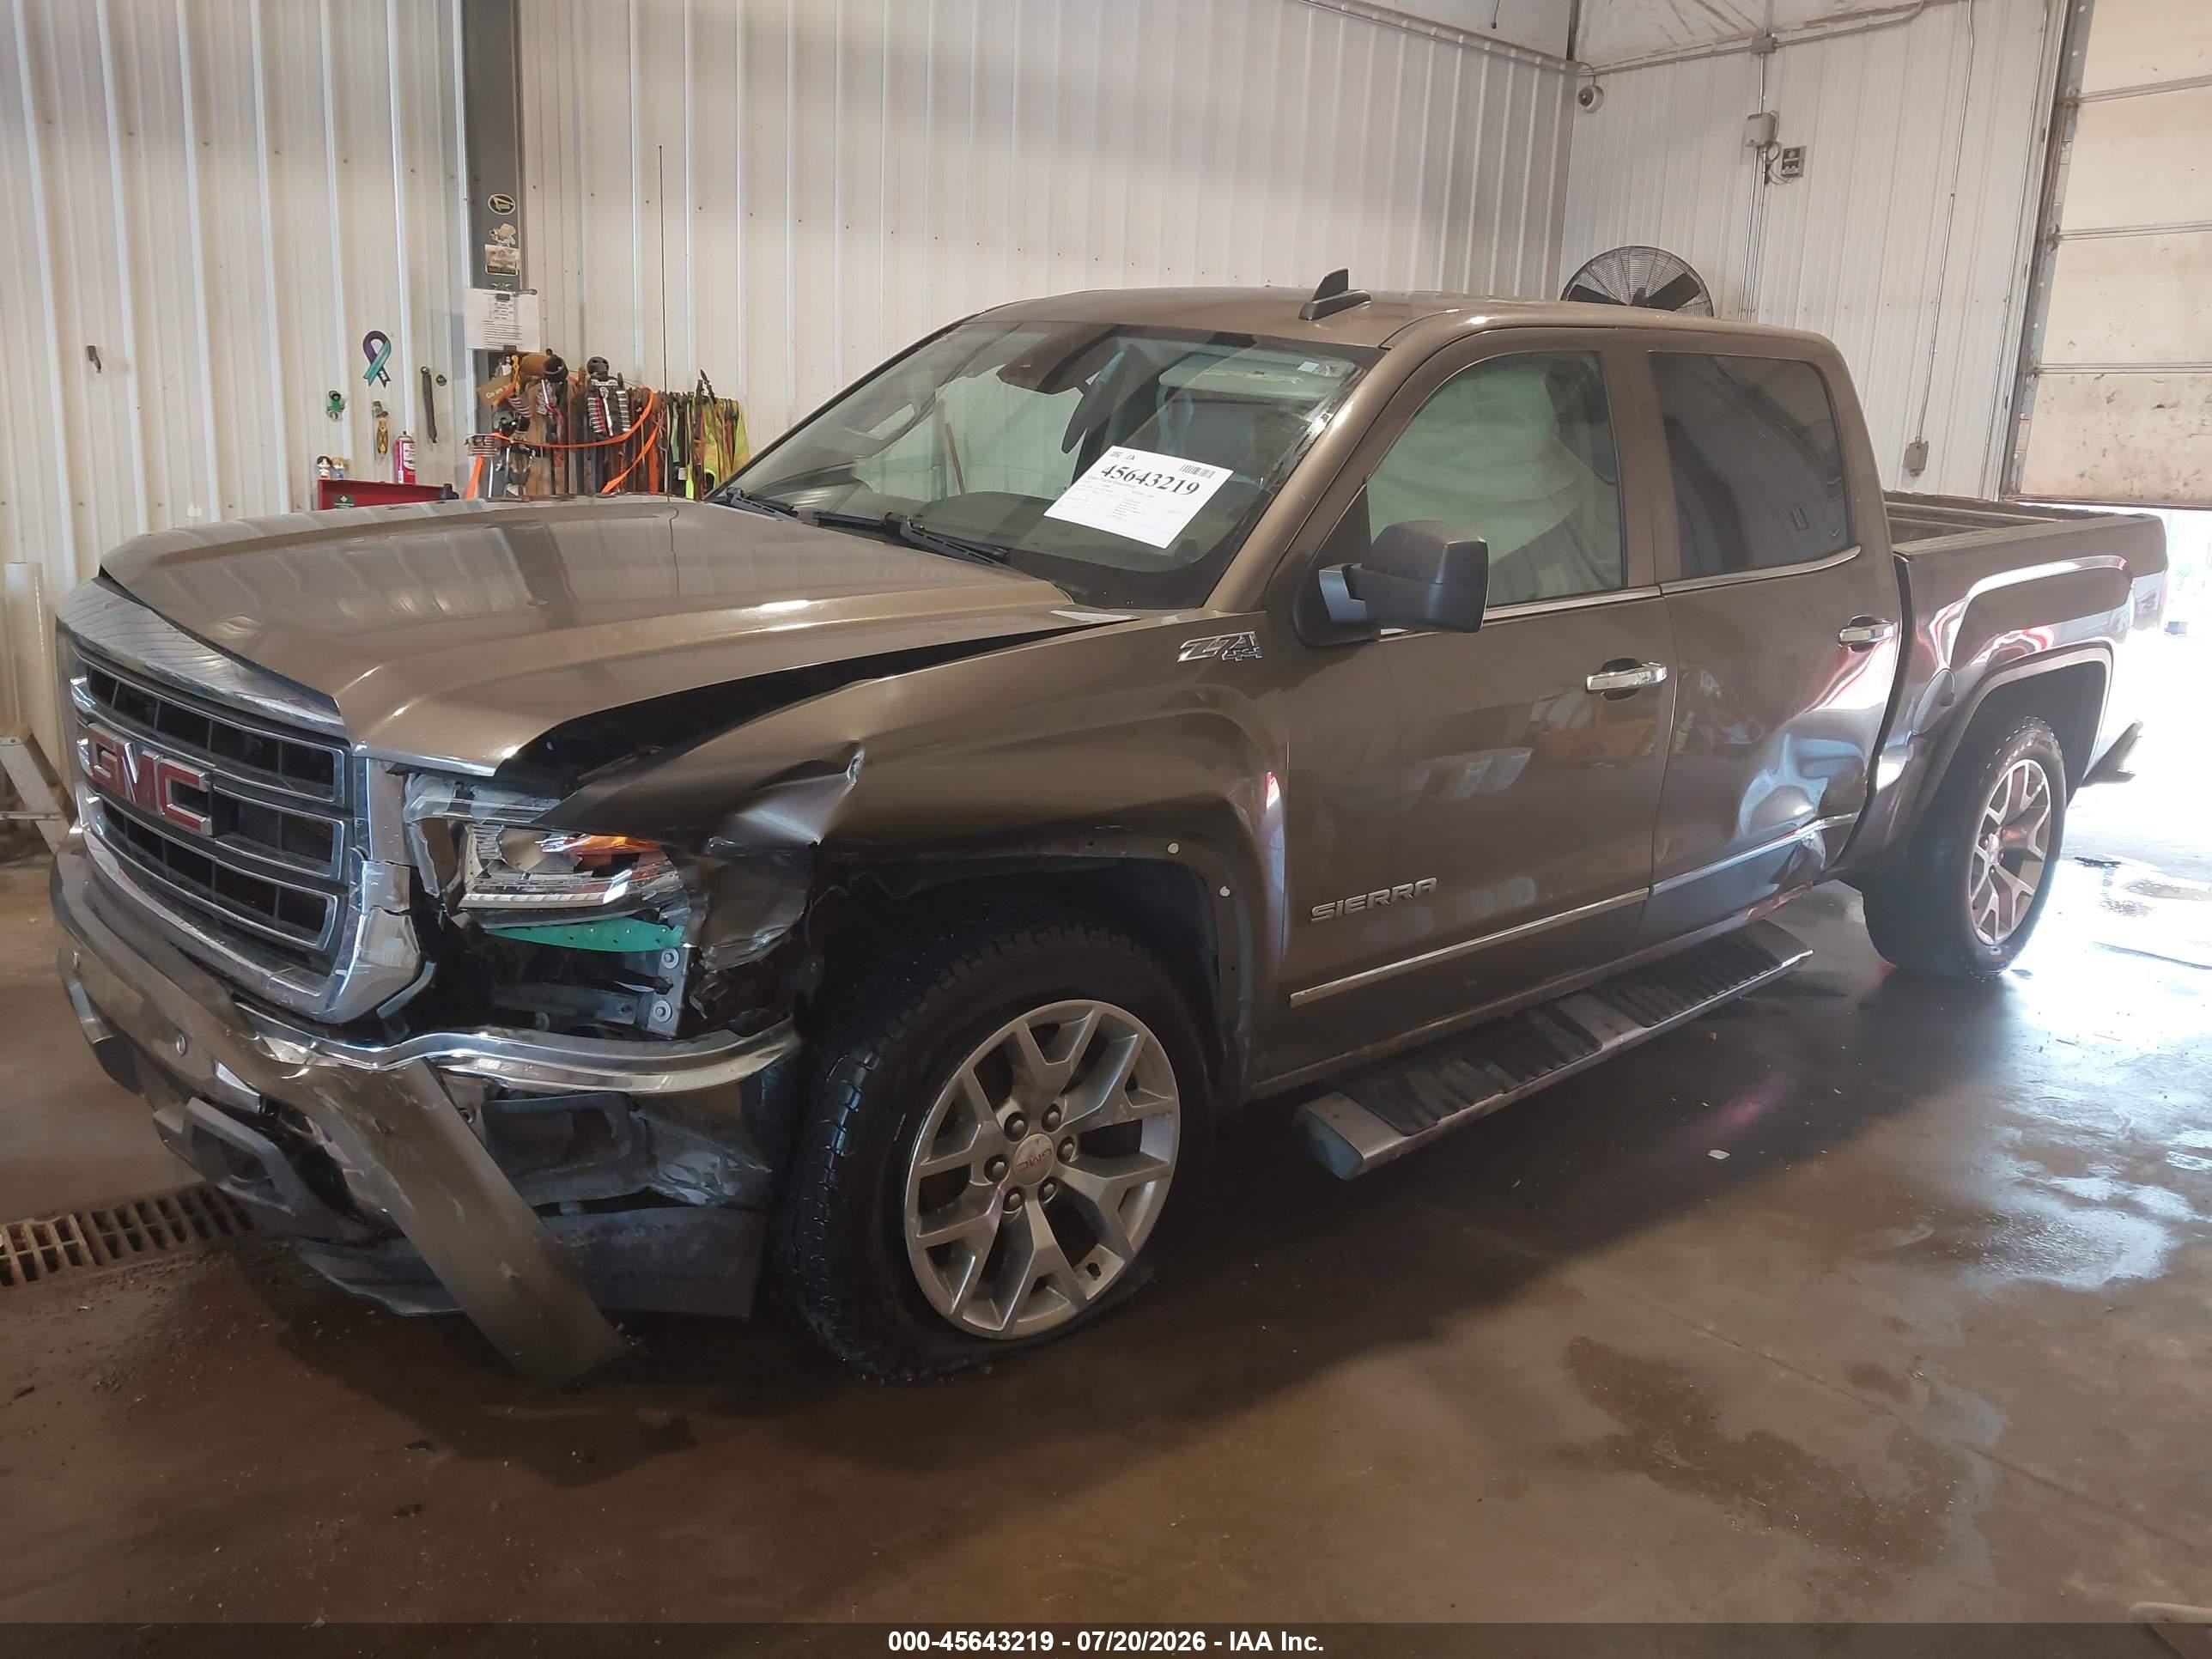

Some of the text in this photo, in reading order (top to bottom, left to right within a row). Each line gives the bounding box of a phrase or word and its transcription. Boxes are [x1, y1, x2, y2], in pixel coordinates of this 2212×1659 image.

[1101, 465, 1200, 495] 45643219
[77, 722, 213, 836] GMC
[1310, 877, 1437, 922] SIERRA
[1016, 1148, 1052, 1170] GMC
